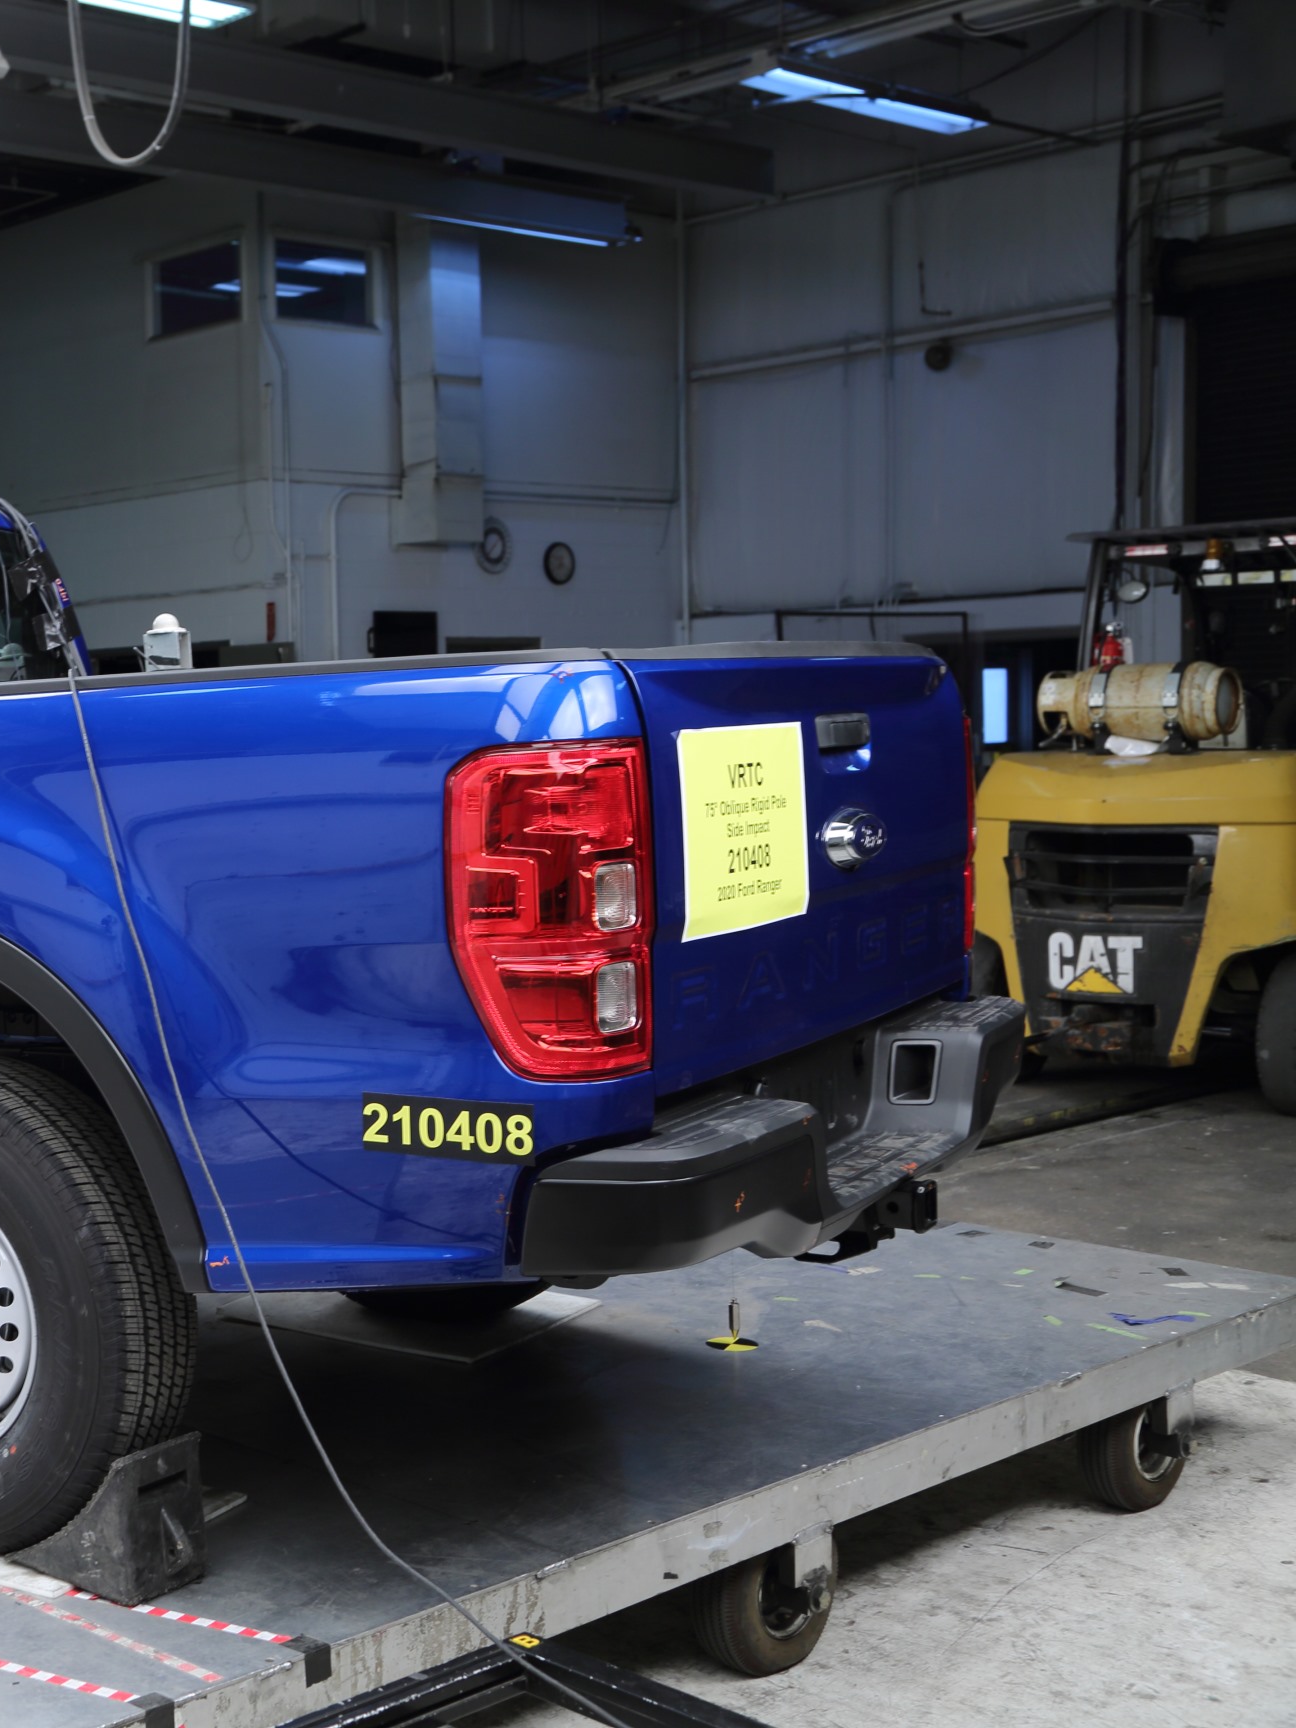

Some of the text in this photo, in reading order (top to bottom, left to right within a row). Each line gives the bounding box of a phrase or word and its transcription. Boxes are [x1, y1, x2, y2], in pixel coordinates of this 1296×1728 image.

[727, 762, 764, 789] VRTC
[720, 800, 750, 818] Oblique
[751, 796, 770, 814] Rigid
[771, 795, 787, 809] Pole
[726, 820, 770, 838] Side Impact
[728, 843, 771, 873] 210408
[717, 878, 782, 902] 2020 Ford Ranger
[1048, 931, 1143, 994] CAT
[362, 1102, 534, 1156] 210408
